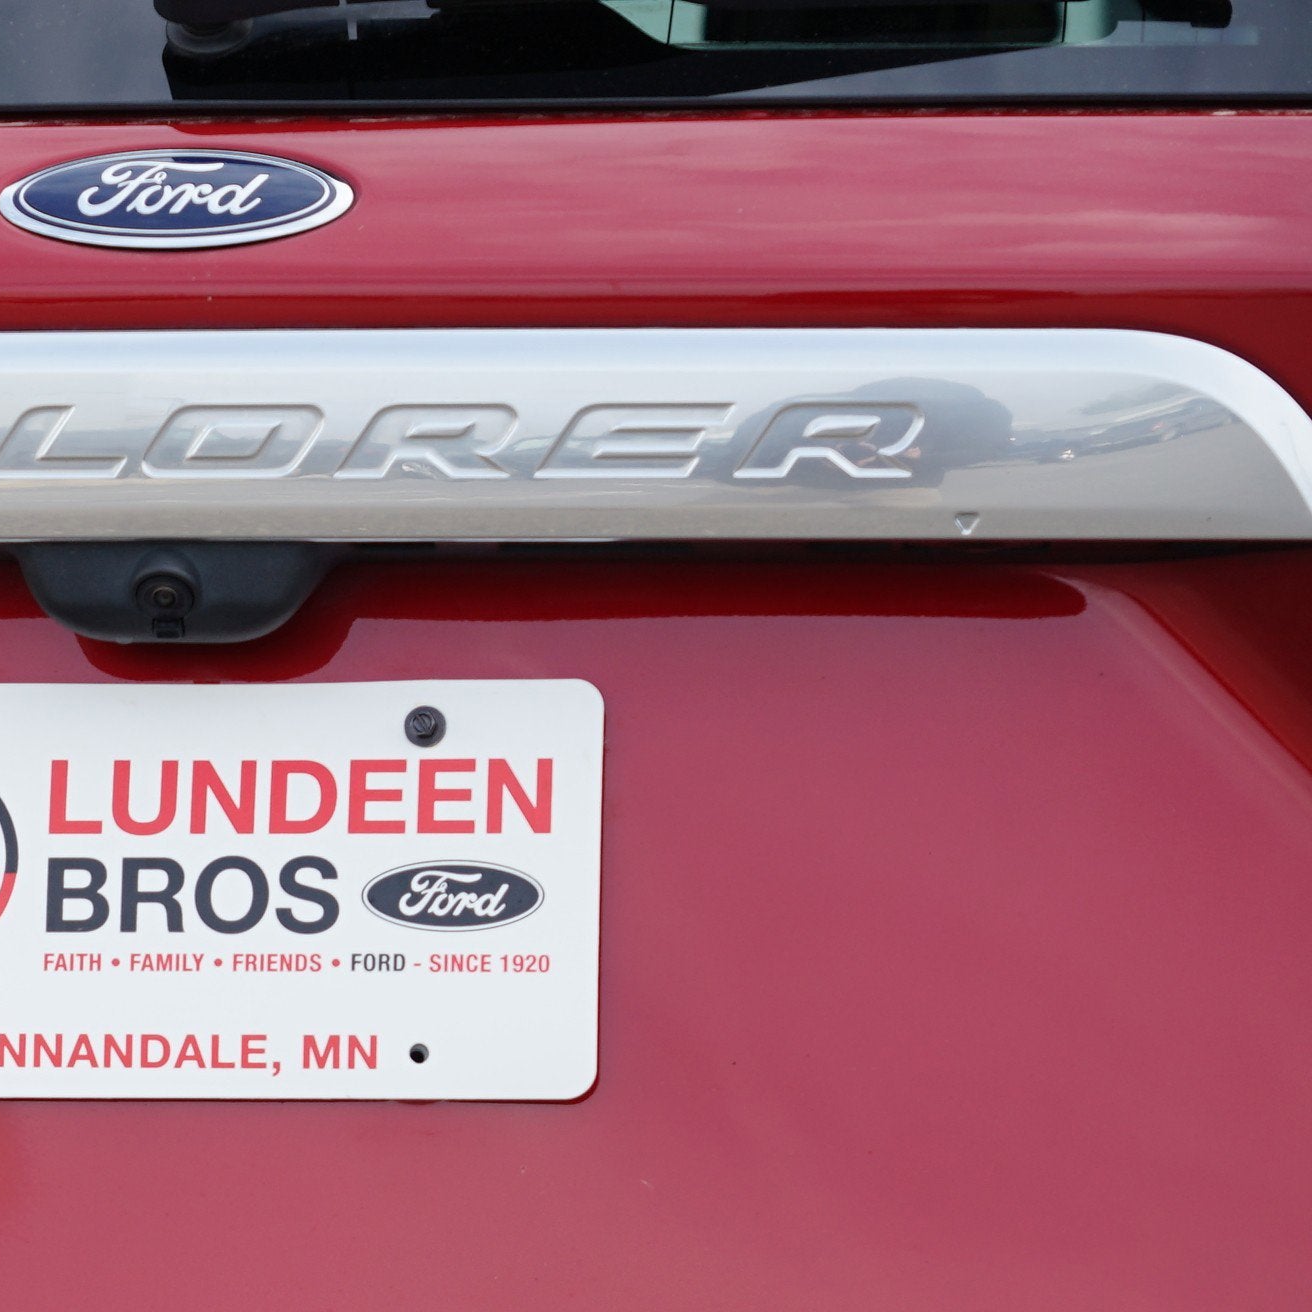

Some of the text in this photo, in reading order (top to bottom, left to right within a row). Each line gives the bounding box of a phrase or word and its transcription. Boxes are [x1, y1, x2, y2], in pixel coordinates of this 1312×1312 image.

[76, 160, 270, 217] Ford
[48, 757, 554, 836] LUNDEEN
[45, 855, 340, 935] BROS
[398, 868, 508, 918] Ford
[43, 953, 550, 973] FAITH FAMILY FRIENDS FORD SINCE 1920
[302, 1034, 378, 1070] MN
